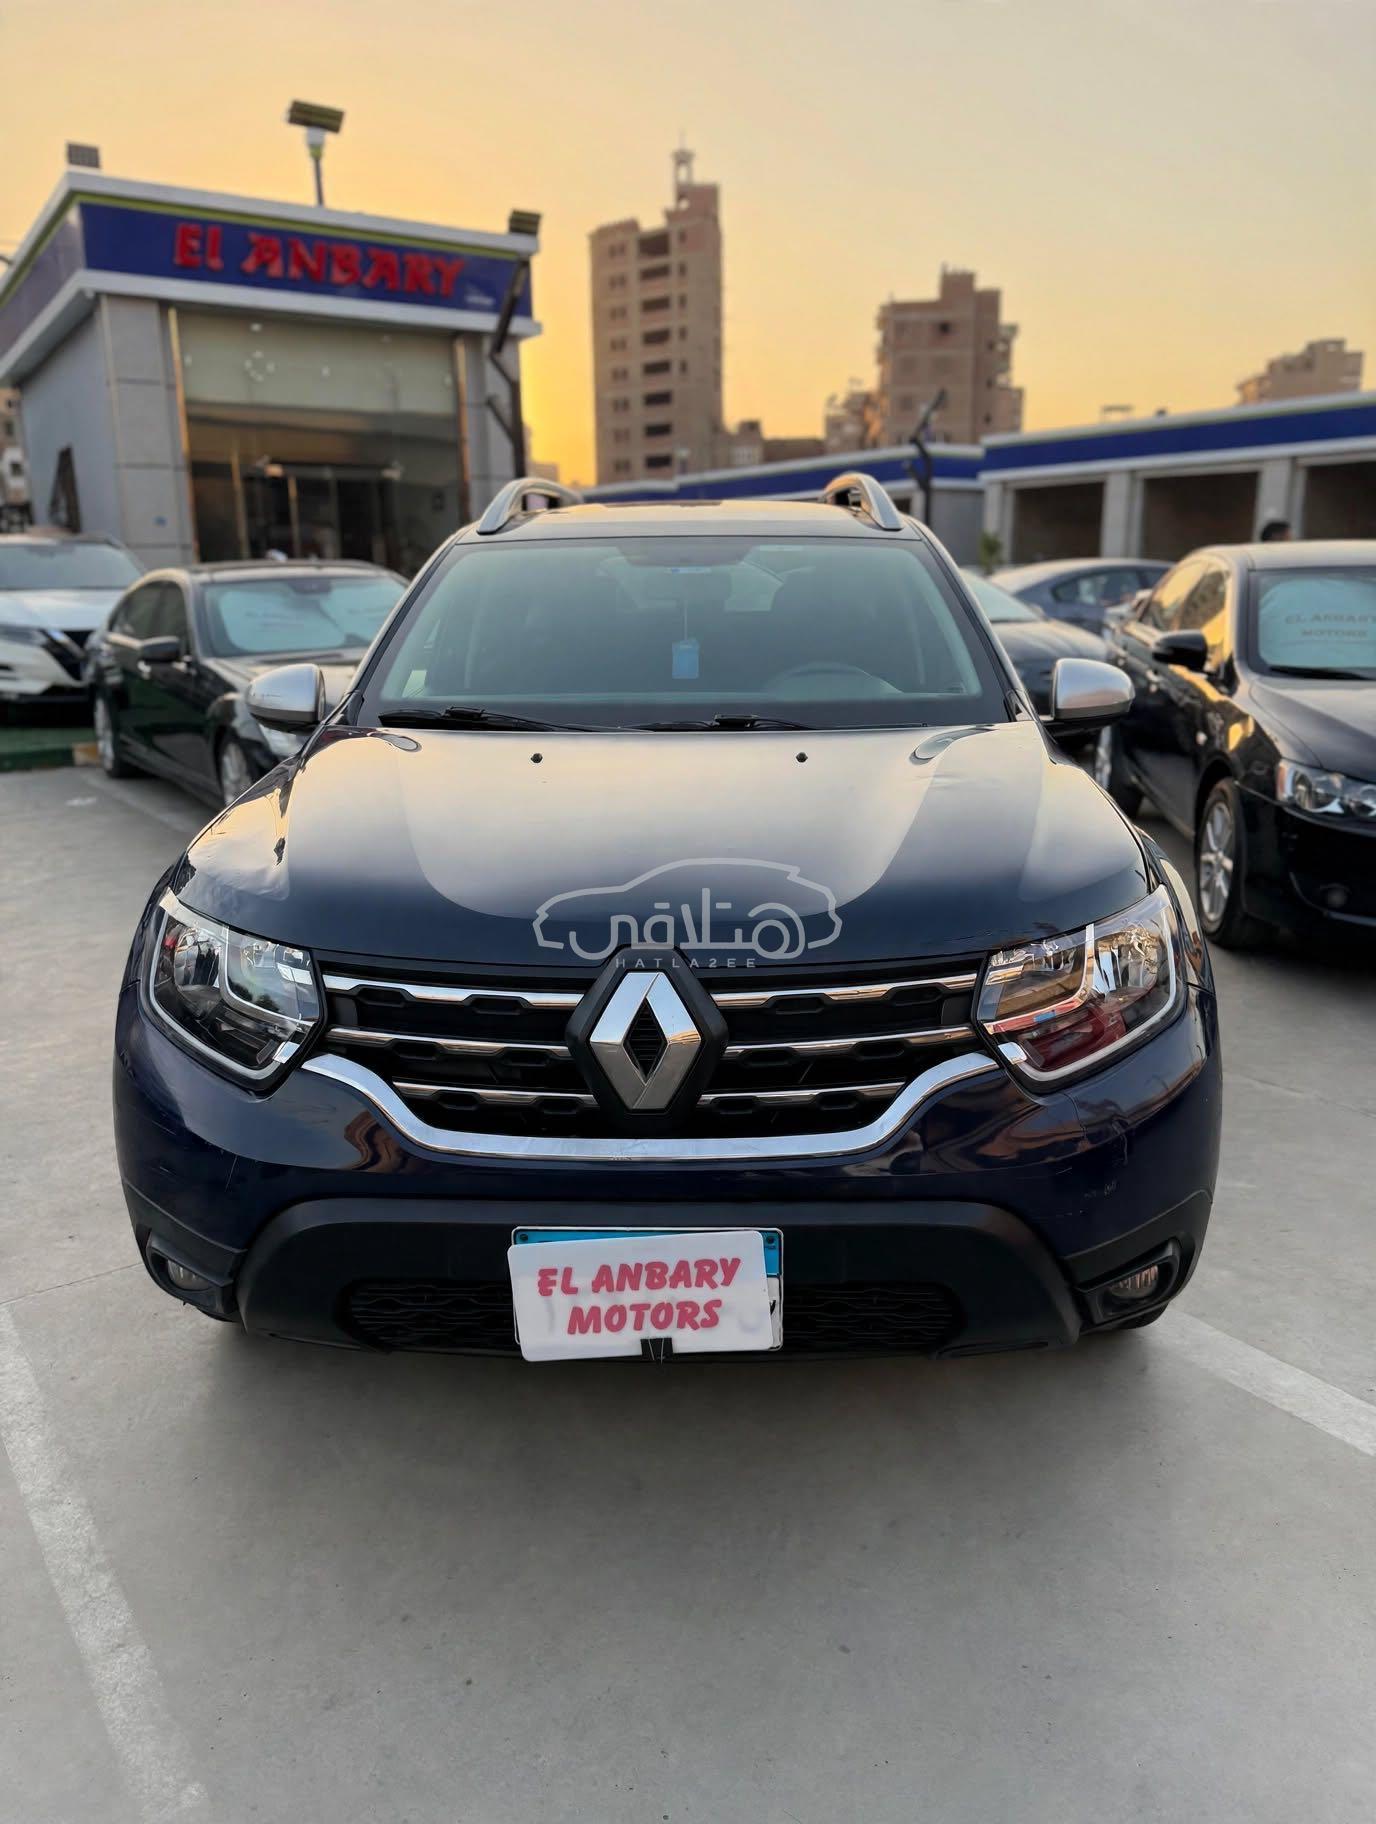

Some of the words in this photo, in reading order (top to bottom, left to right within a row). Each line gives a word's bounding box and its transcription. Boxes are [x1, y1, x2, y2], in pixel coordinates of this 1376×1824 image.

[241, 232, 464, 298] ANBARY
[537, 1266, 579, 1297] EL
[591, 1257, 741, 1293] ANBARY
[567, 1299, 722, 1335] MOTORS
